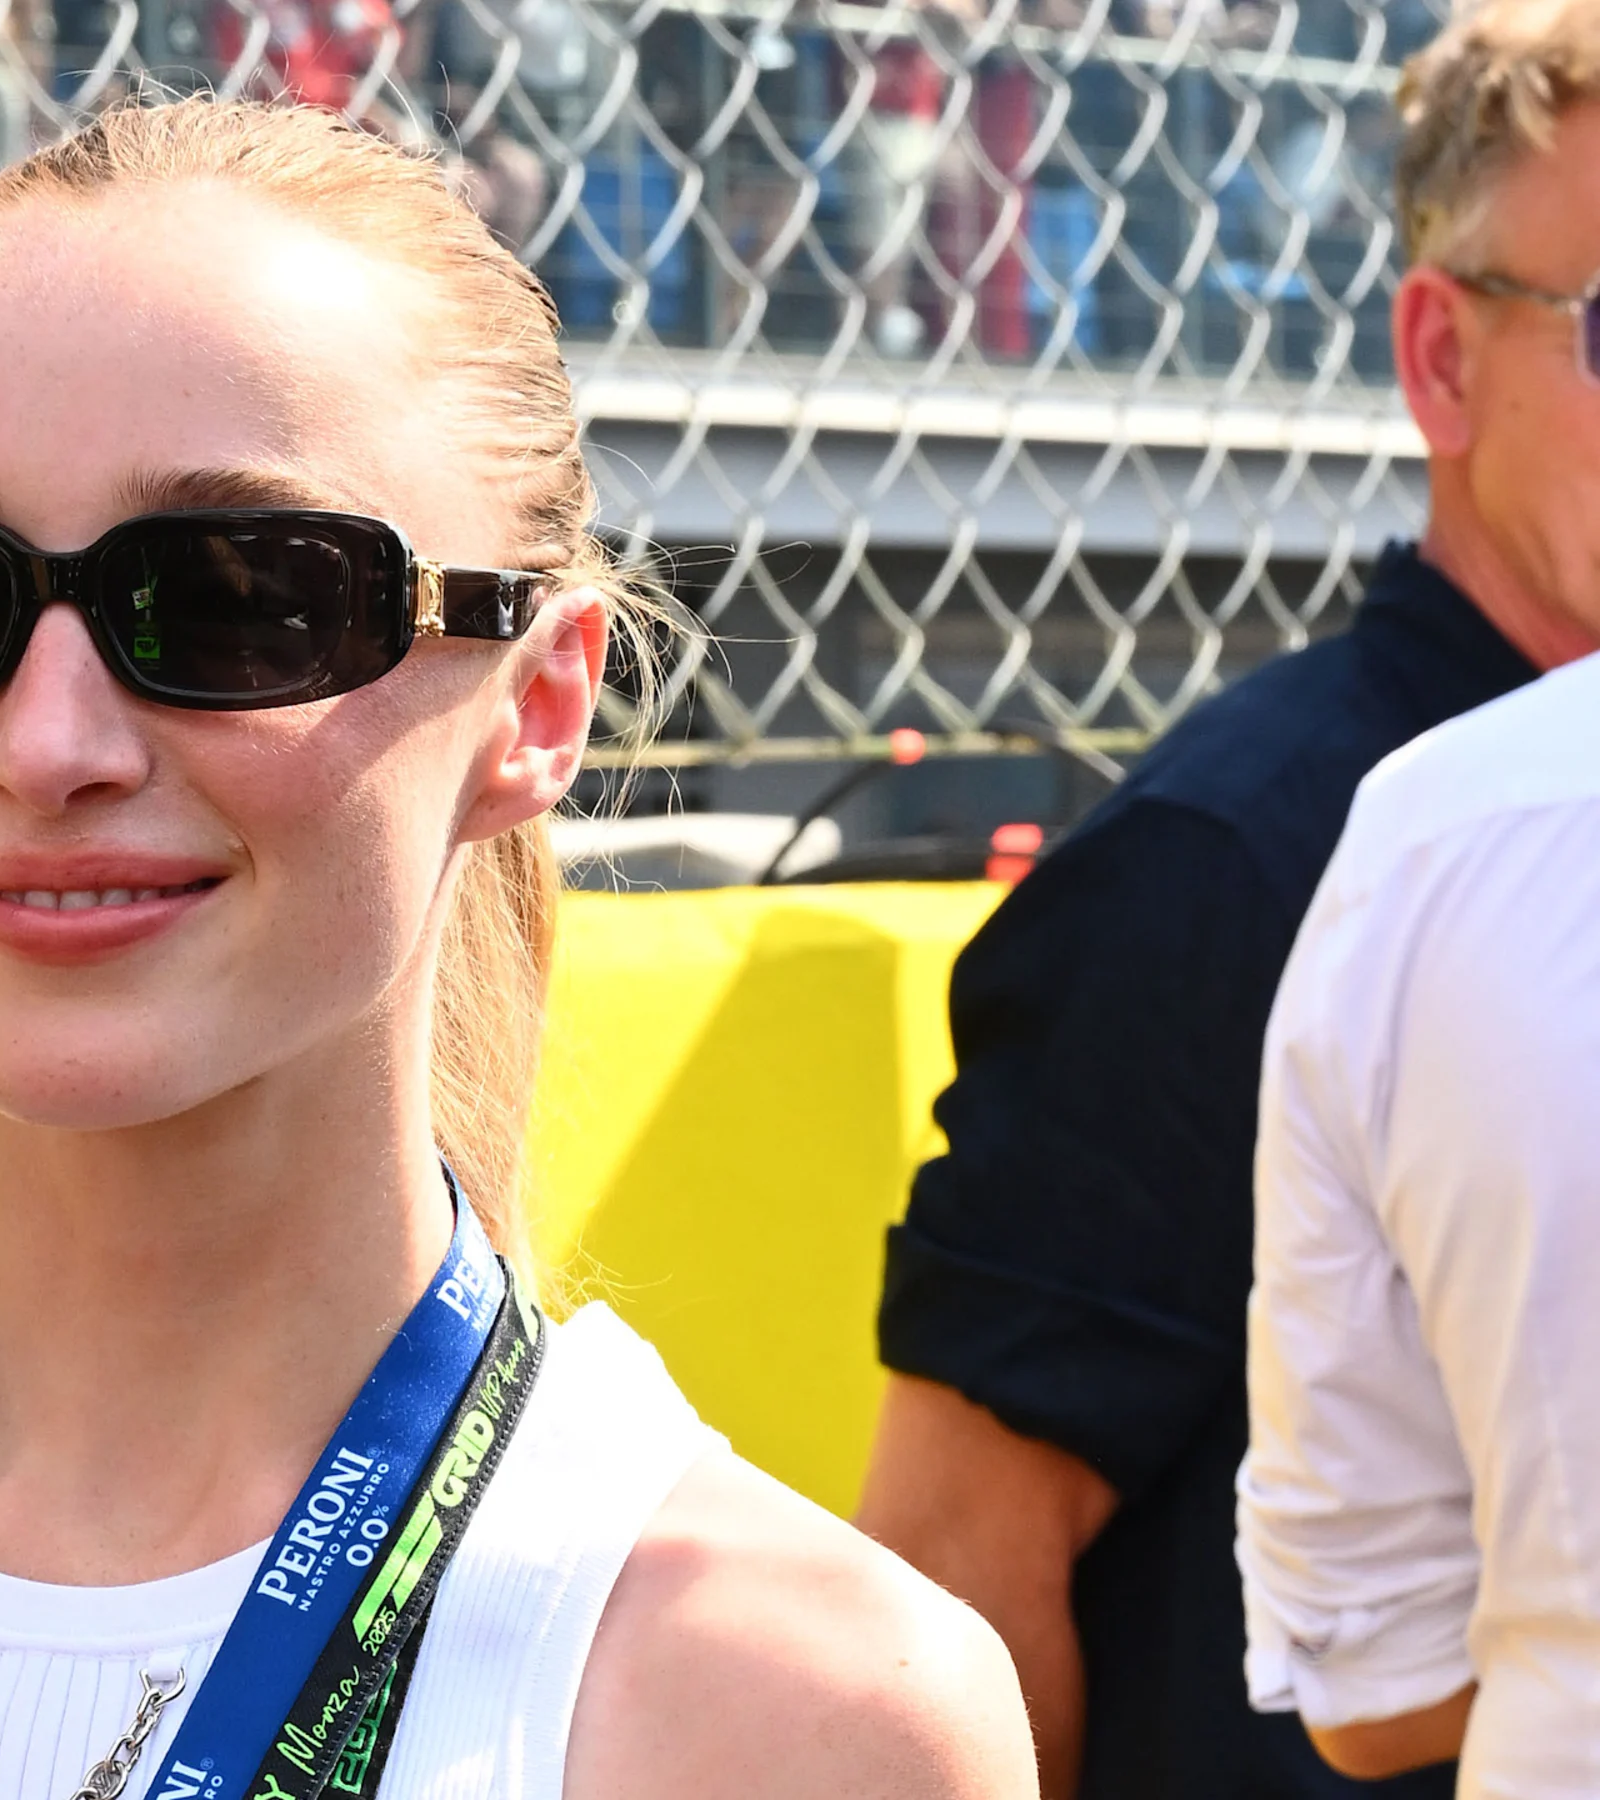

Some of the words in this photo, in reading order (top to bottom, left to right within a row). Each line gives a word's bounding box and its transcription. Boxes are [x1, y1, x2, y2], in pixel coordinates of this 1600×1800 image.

[256, 1447, 375, 1606] PERONI
[275, 1665, 360, 1776] Monza
[362, 1606, 398, 1656] 2025
[431, 1410, 495, 1507] GRID
[476, 1372, 506, 1420] VIP
[298, 1543, 341, 1611] NASTRO
[338, 1463, 390, 1539] AZZURRO
[346, 1505, 390, 1567] 0.0%
